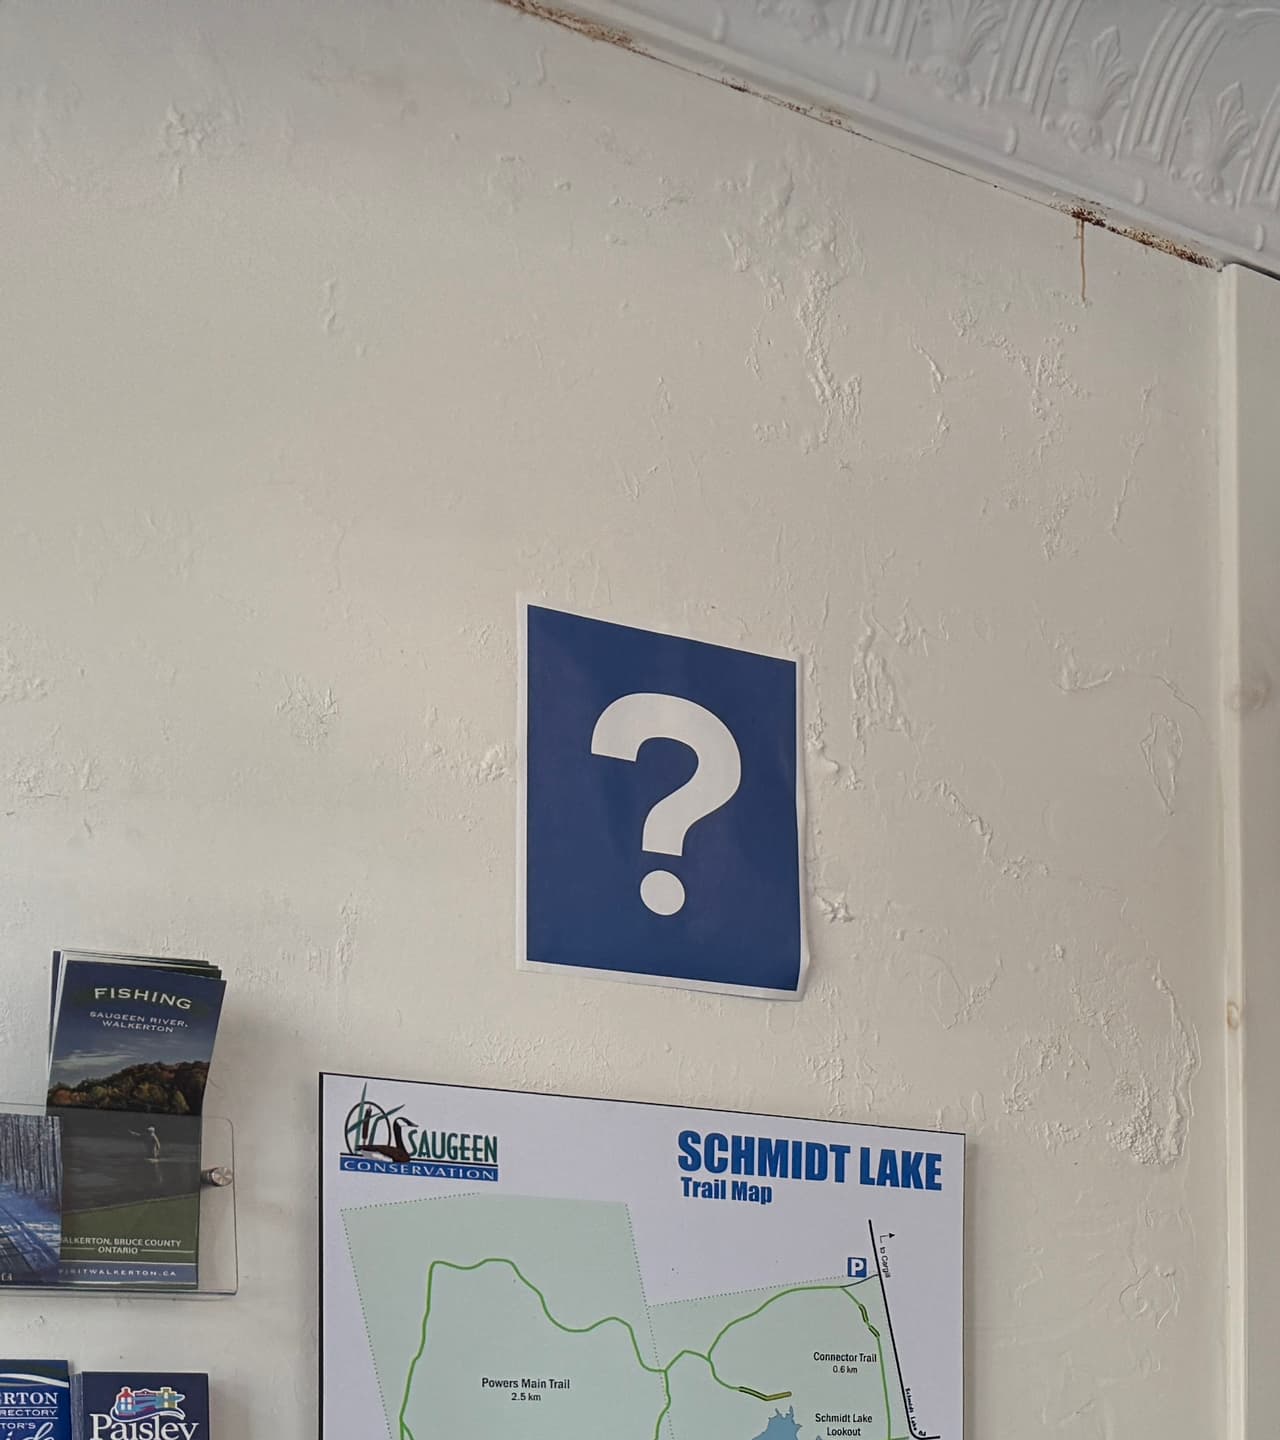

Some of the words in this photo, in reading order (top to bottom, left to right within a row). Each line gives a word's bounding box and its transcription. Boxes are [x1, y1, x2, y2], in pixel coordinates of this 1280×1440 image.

[591, 692, 741, 916] ?
[95, 988, 192, 1009] FISHING
[90, 1011, 145, 1022] SAUGEEN
[102, 1021, 174, 1033] WALKERTON
[408, 1128, 498, 1163] SAUGEEN
[678, 1130, 851, 1183] SCHMIDT
[860, 1147, 942, 1191] LAKE
[344, 1160, 495, 1180] CONSERVATION
[681, 1177, 726, 1200] Trail
[731, 1181, 772, 1205] Map
[114, 1238, 143, 1246] BRUCE
[145, 1239, 182, 1247] COUNTY
[98, 1246, 138, 1254] ONTARIO
[813, 1352, 857, 1362] Connector
[859, 1353, 877, 1362] Trail
[482, 1377, 518, 1388] Powers
[521, 1378, 546, 1388] Main
[549, 1379, 570, 1389] Trail
[511, 1393, 526, 1401] 2.5
[528, 1393, 541, 1401] km
[815, 1413, 851, 1423] Schmidt
[853, 1413, 872, 1423] Lake
[827, 1427, 861, 1436] Lookout
